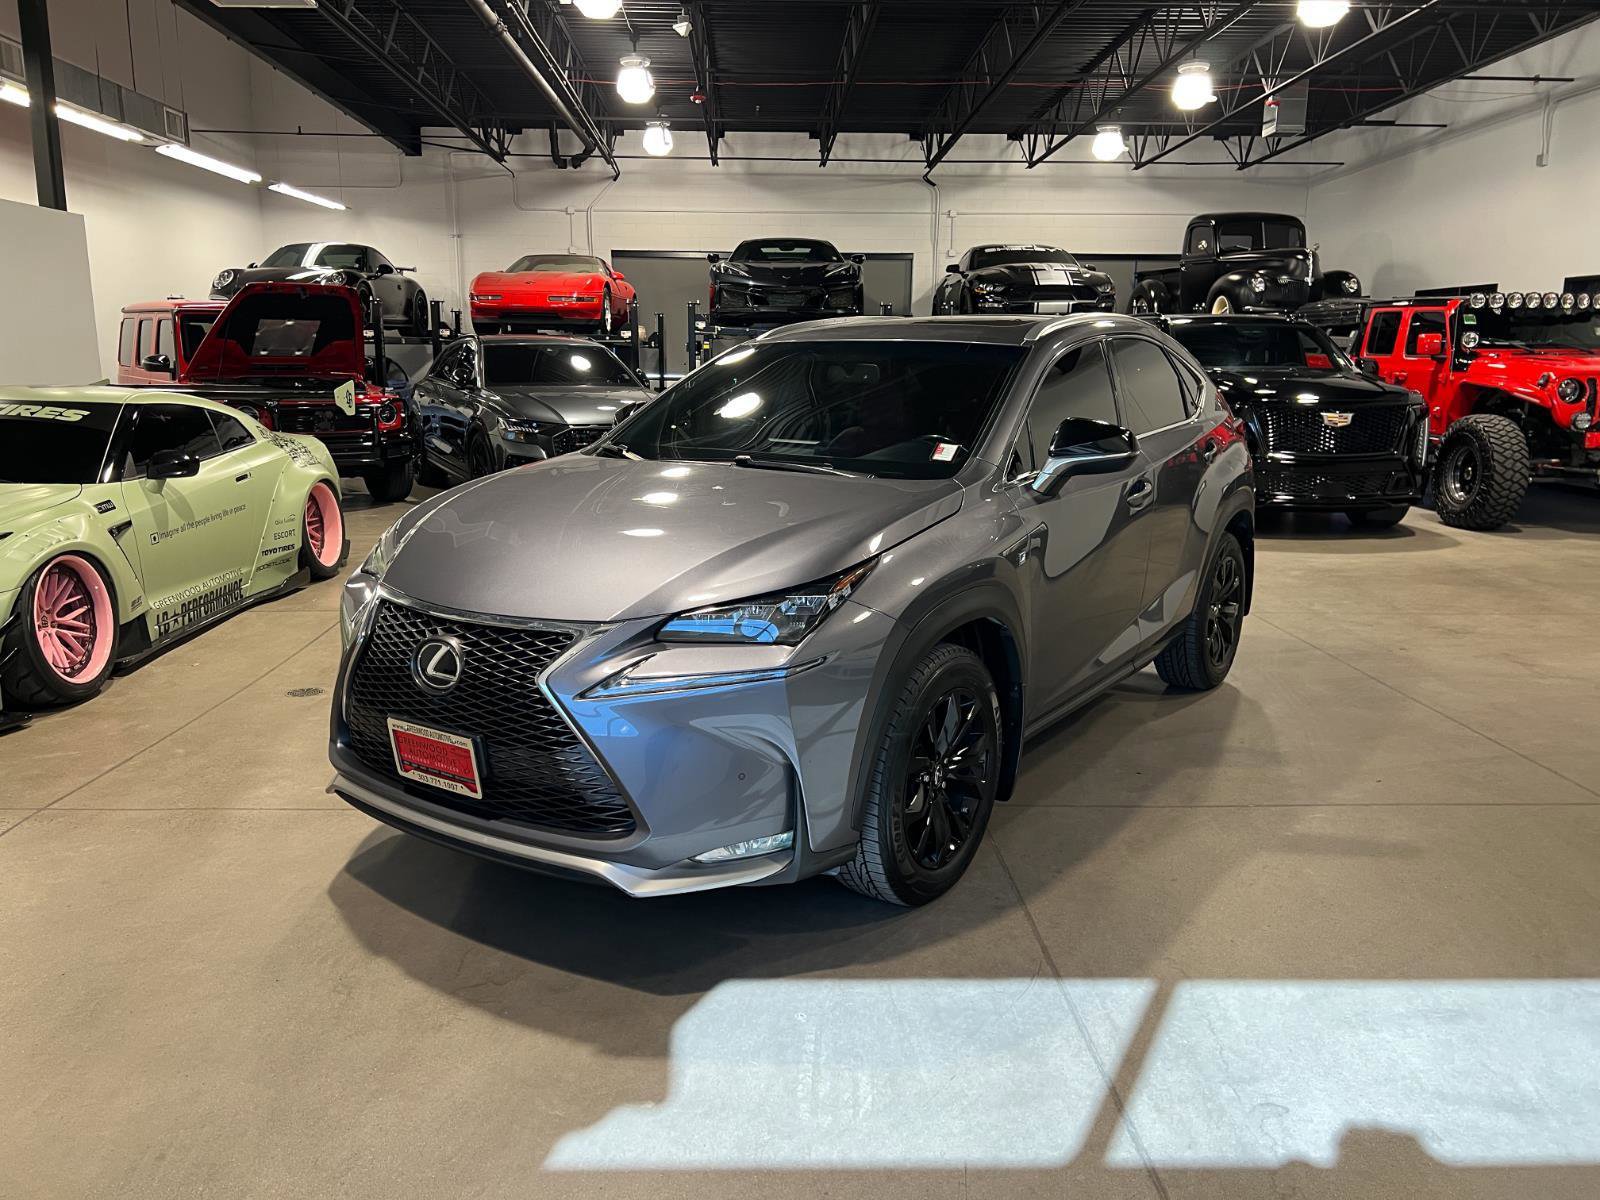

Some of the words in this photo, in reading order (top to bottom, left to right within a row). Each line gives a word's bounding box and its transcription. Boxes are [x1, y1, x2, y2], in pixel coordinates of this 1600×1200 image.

[273, 528, 296, 541] ESCORT
[261, 546, 278, 557] TOYO
[278, 543, 296, 553] TIRES
[153, 584, 201, 610] GREENWOOD
[202, 567, 244, 590] AUTOMOTIVE
[180, 578, 244, 627] PERFORMANCE
